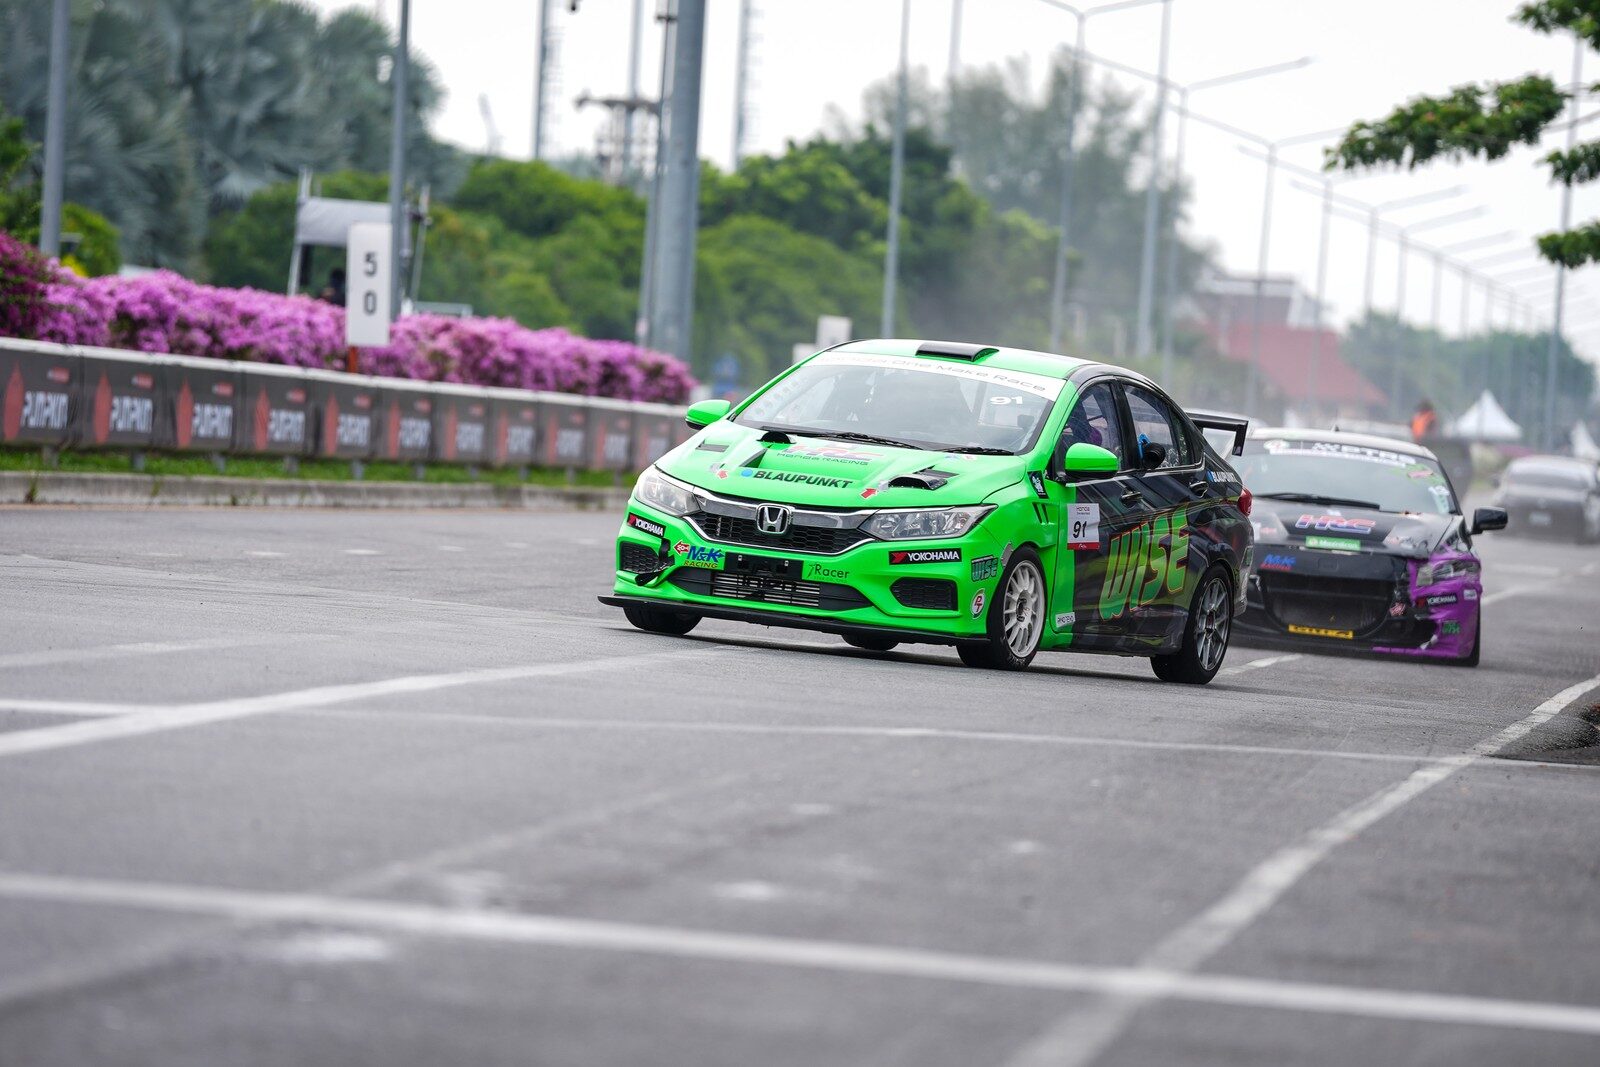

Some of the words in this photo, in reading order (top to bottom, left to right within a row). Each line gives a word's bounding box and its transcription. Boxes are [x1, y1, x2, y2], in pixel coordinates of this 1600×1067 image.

[363, 251, 377, 315] 50
[891, 360, 932, 370] One
[937, 364, 989, 378] Make
[993, 374, 1047, 393] Race
[990, 396, 1025, 405] 91
[821, 457, 869, 467] RACING
[753, 470, 853, 489] BLAUPUNKT
[635, 518, 664, 537] YOKOHAMA
[1073, 520, 1087, 539] 91
[1295, 514, 1376, 534] HRC
[687, 546, 724, 562] M&K
[907, 551, 960, 561] YOKOHAMA
[1099, 504, 1189, 620] WISE
[684, 560, 718, 568] RACING
